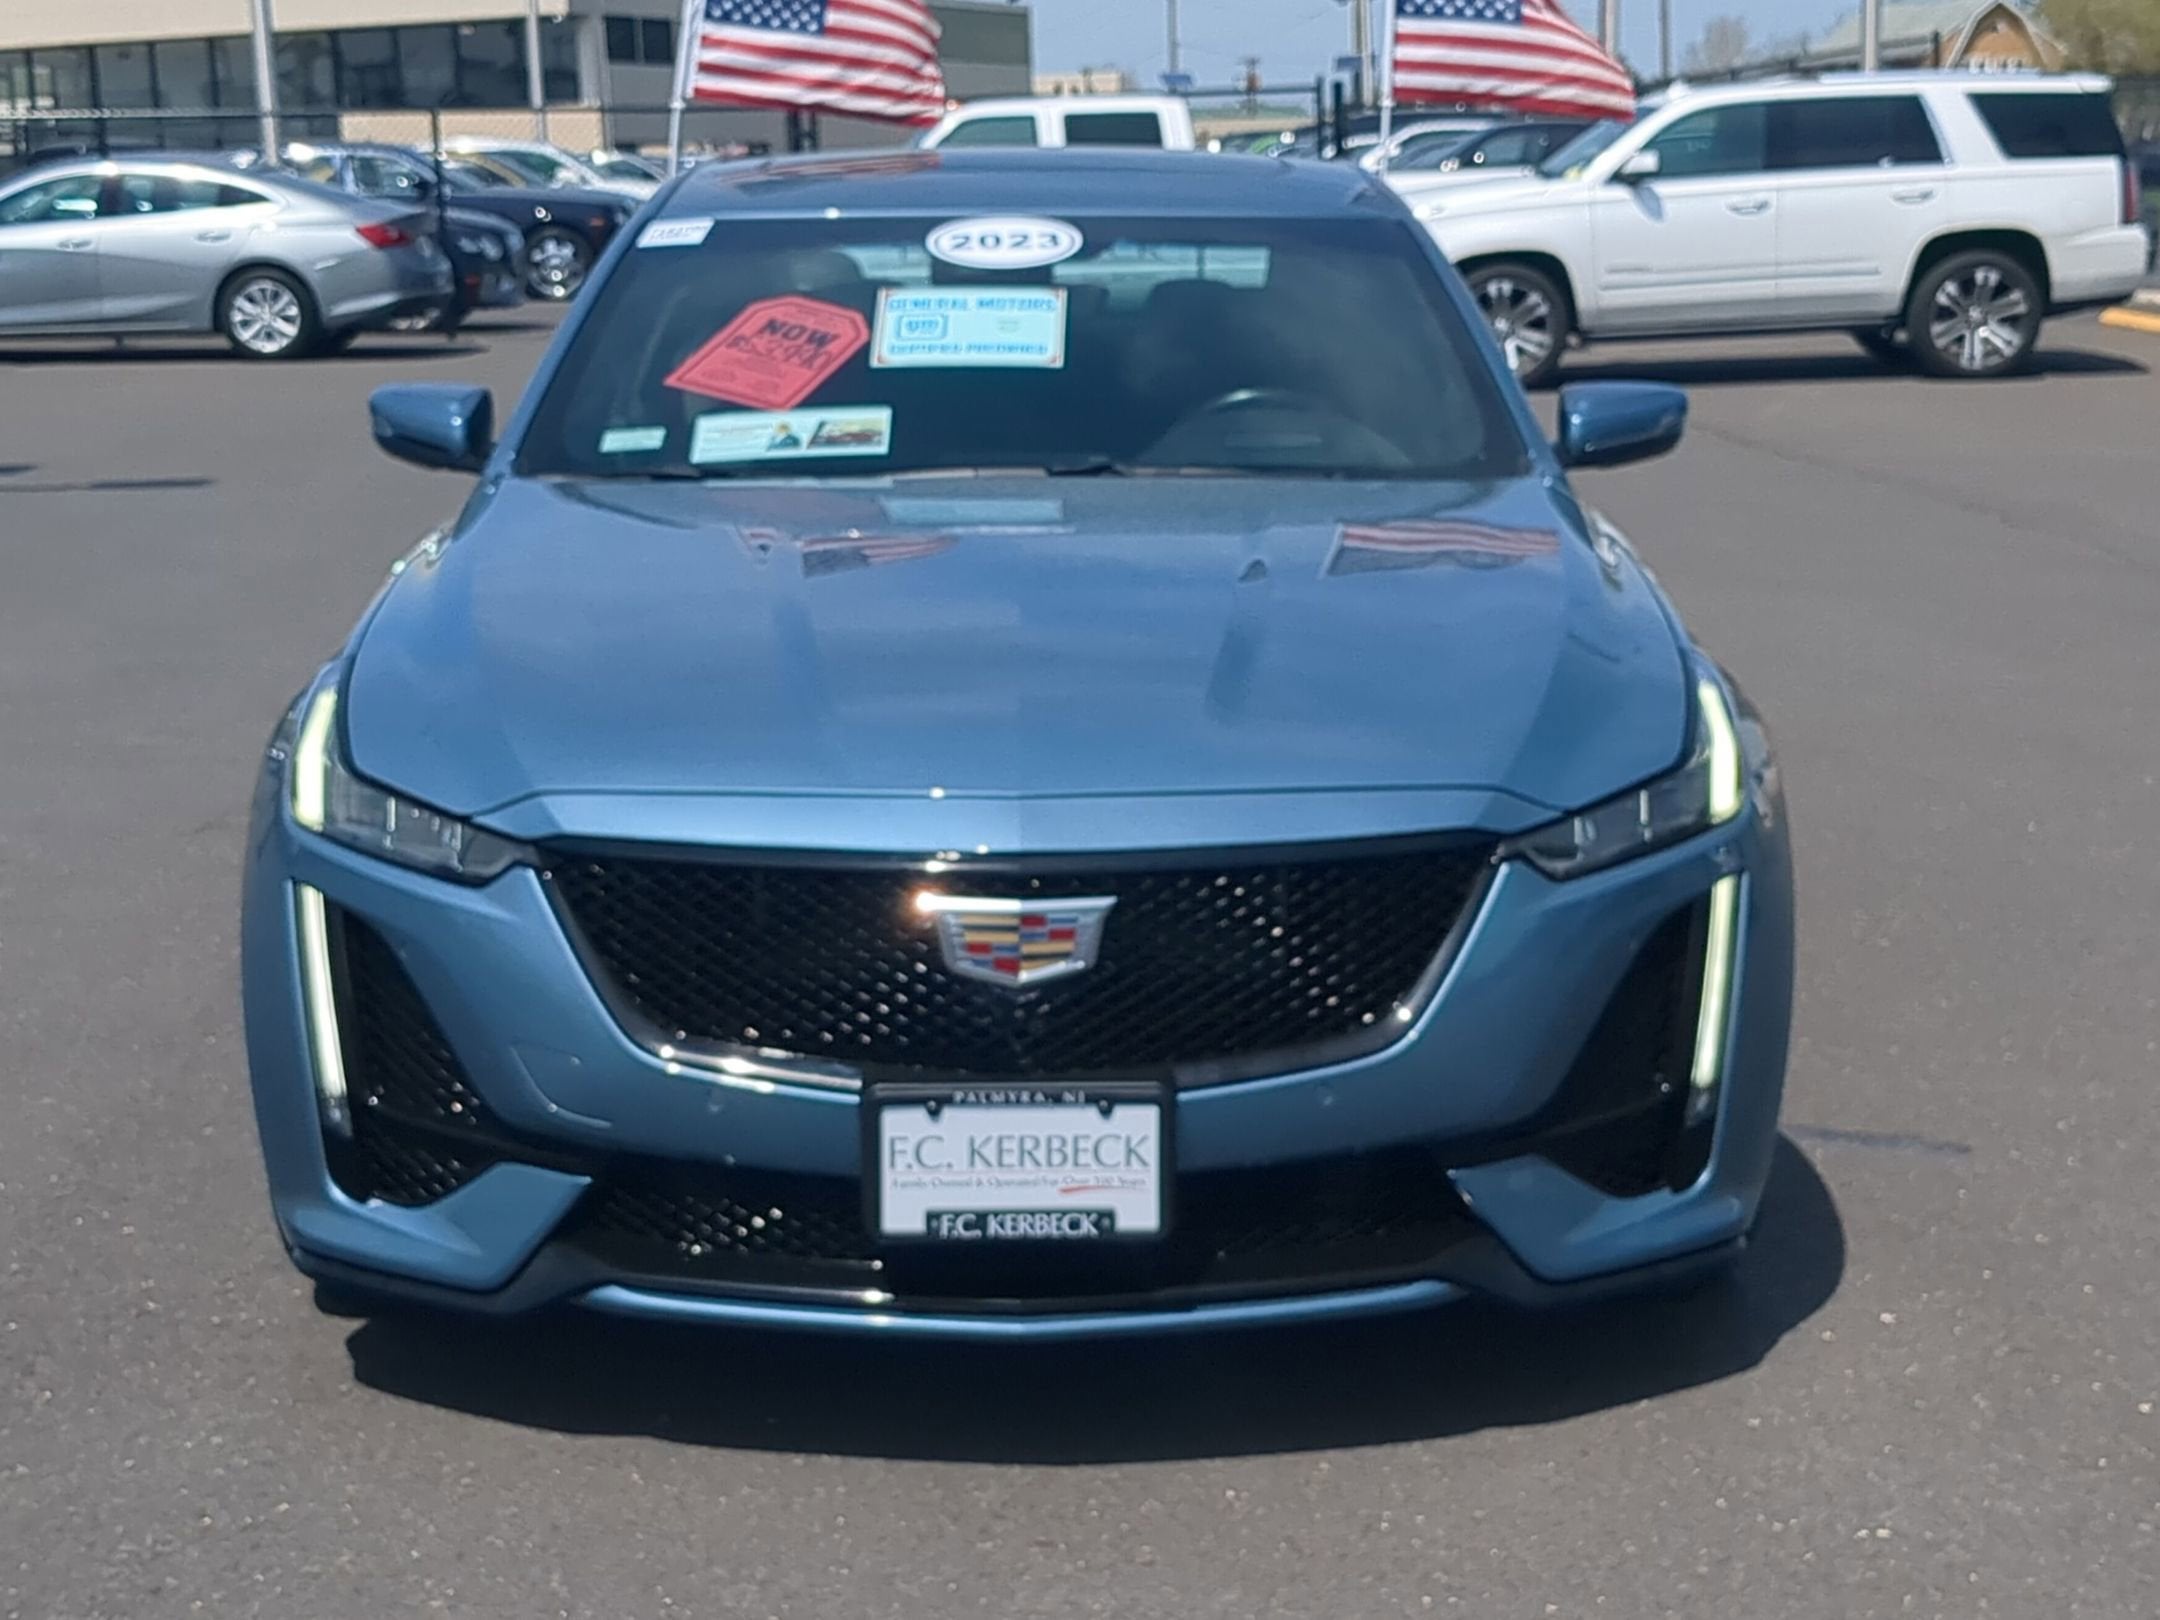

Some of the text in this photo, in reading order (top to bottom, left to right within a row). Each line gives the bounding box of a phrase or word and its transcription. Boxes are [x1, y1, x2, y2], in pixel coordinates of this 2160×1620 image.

[951, 234, 1060, 250] 2023
[757, 319, 842, 348] NOW
[888, 1134, 1151, 1170] F.C. KERBECK
[938, 1212, 1099, 1239] F.C. KERBECK
